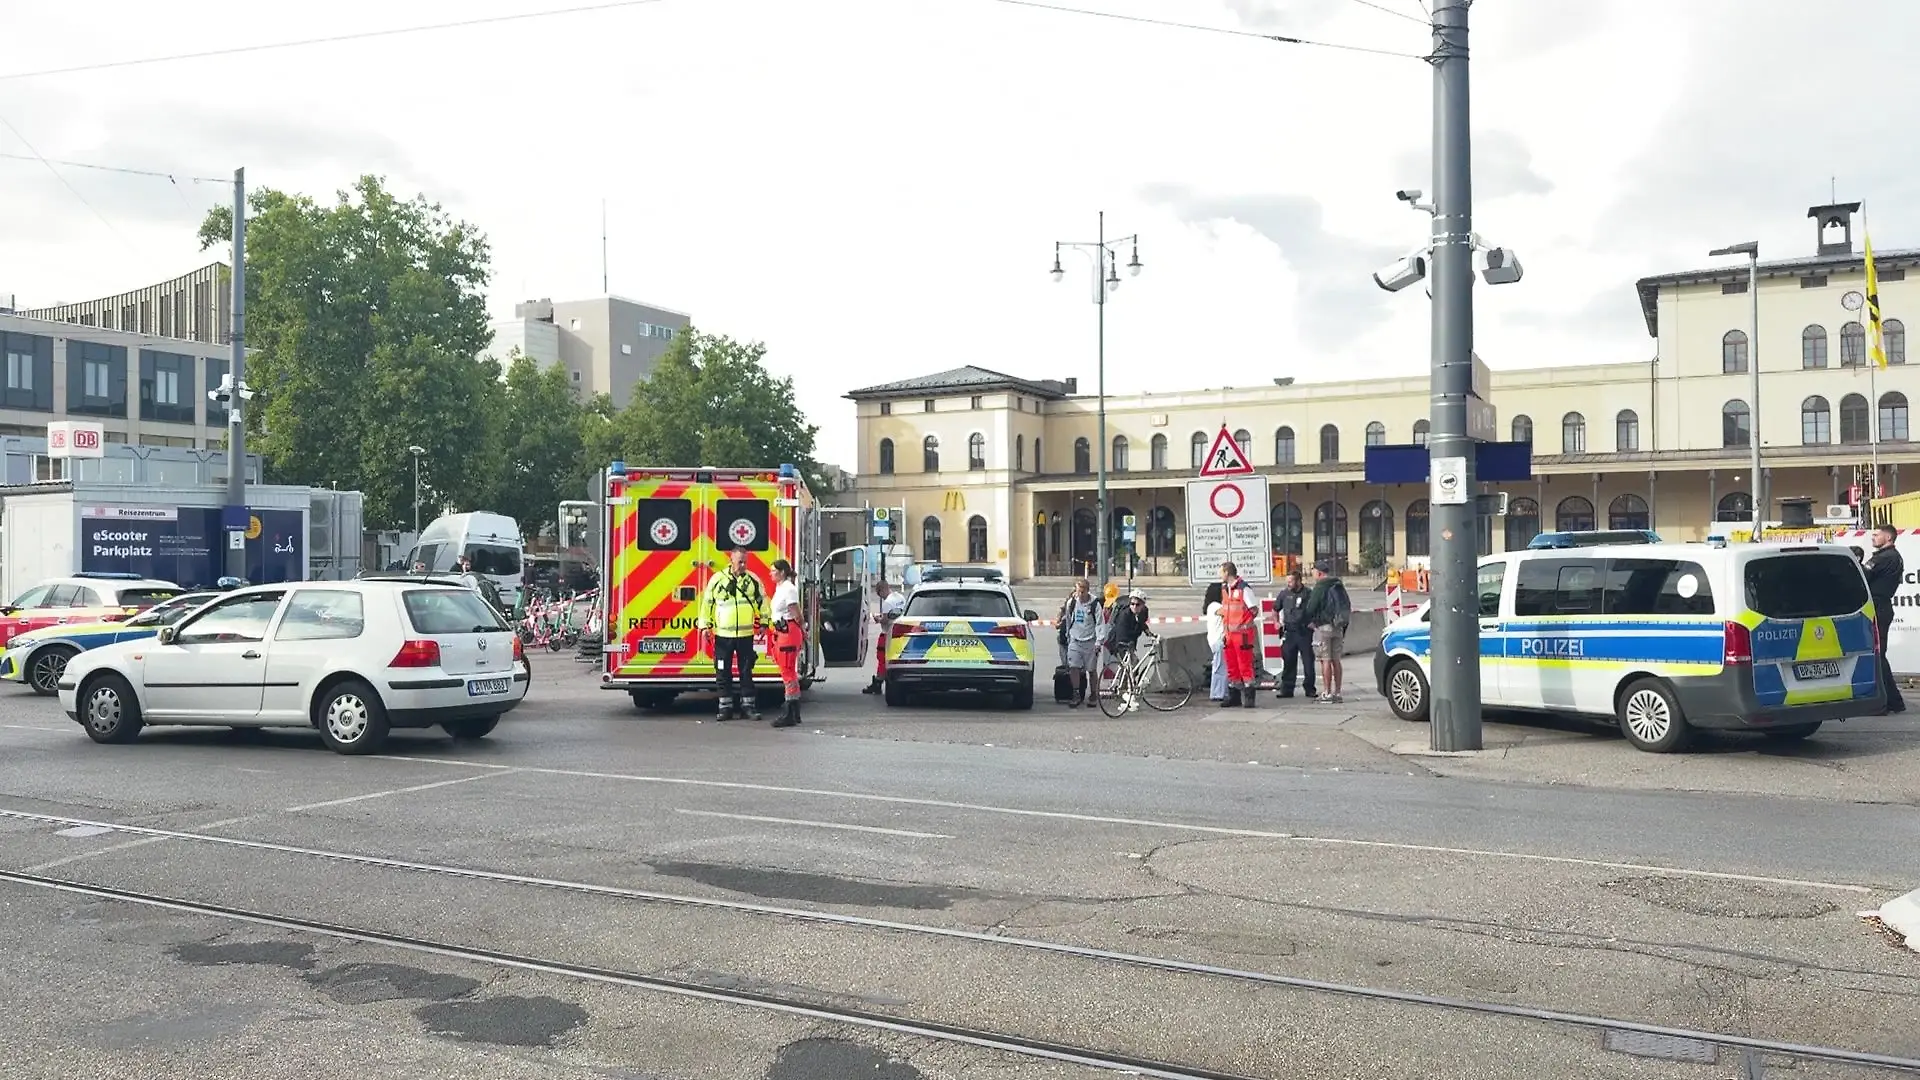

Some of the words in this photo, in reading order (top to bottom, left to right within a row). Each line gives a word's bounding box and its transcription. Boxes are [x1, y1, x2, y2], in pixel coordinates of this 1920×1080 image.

[77, 432, 96, 446] DB
[118, 509, 166, 517] Reisezentrum
[93, 529, 148, 541] eScooter
[93, 545, 153, 559] Parkplatz
[1757, 629, 1798, 642] POLIZEI
[1521, 638, 1584, 656] POLIZEI
